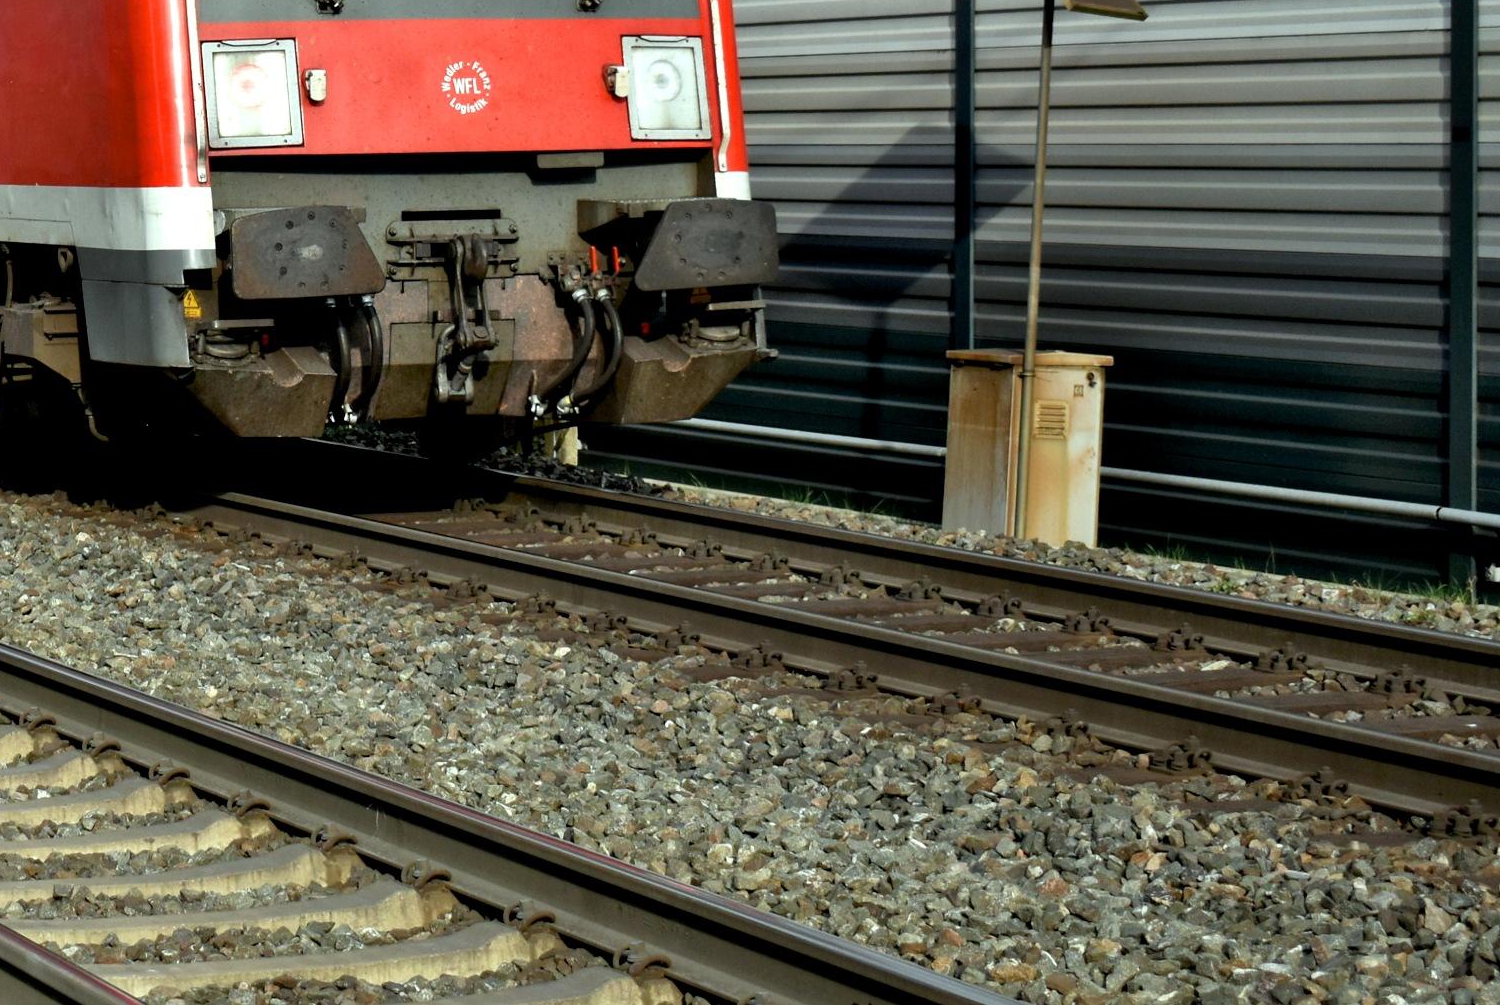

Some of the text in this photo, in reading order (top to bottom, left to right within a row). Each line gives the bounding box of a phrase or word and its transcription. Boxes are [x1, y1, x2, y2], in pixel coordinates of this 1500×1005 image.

[441, 61, 491, 92] Wedler Franz
[452, 77, 481, 95] WFL
[449, 97, 488, 115] Logistik
